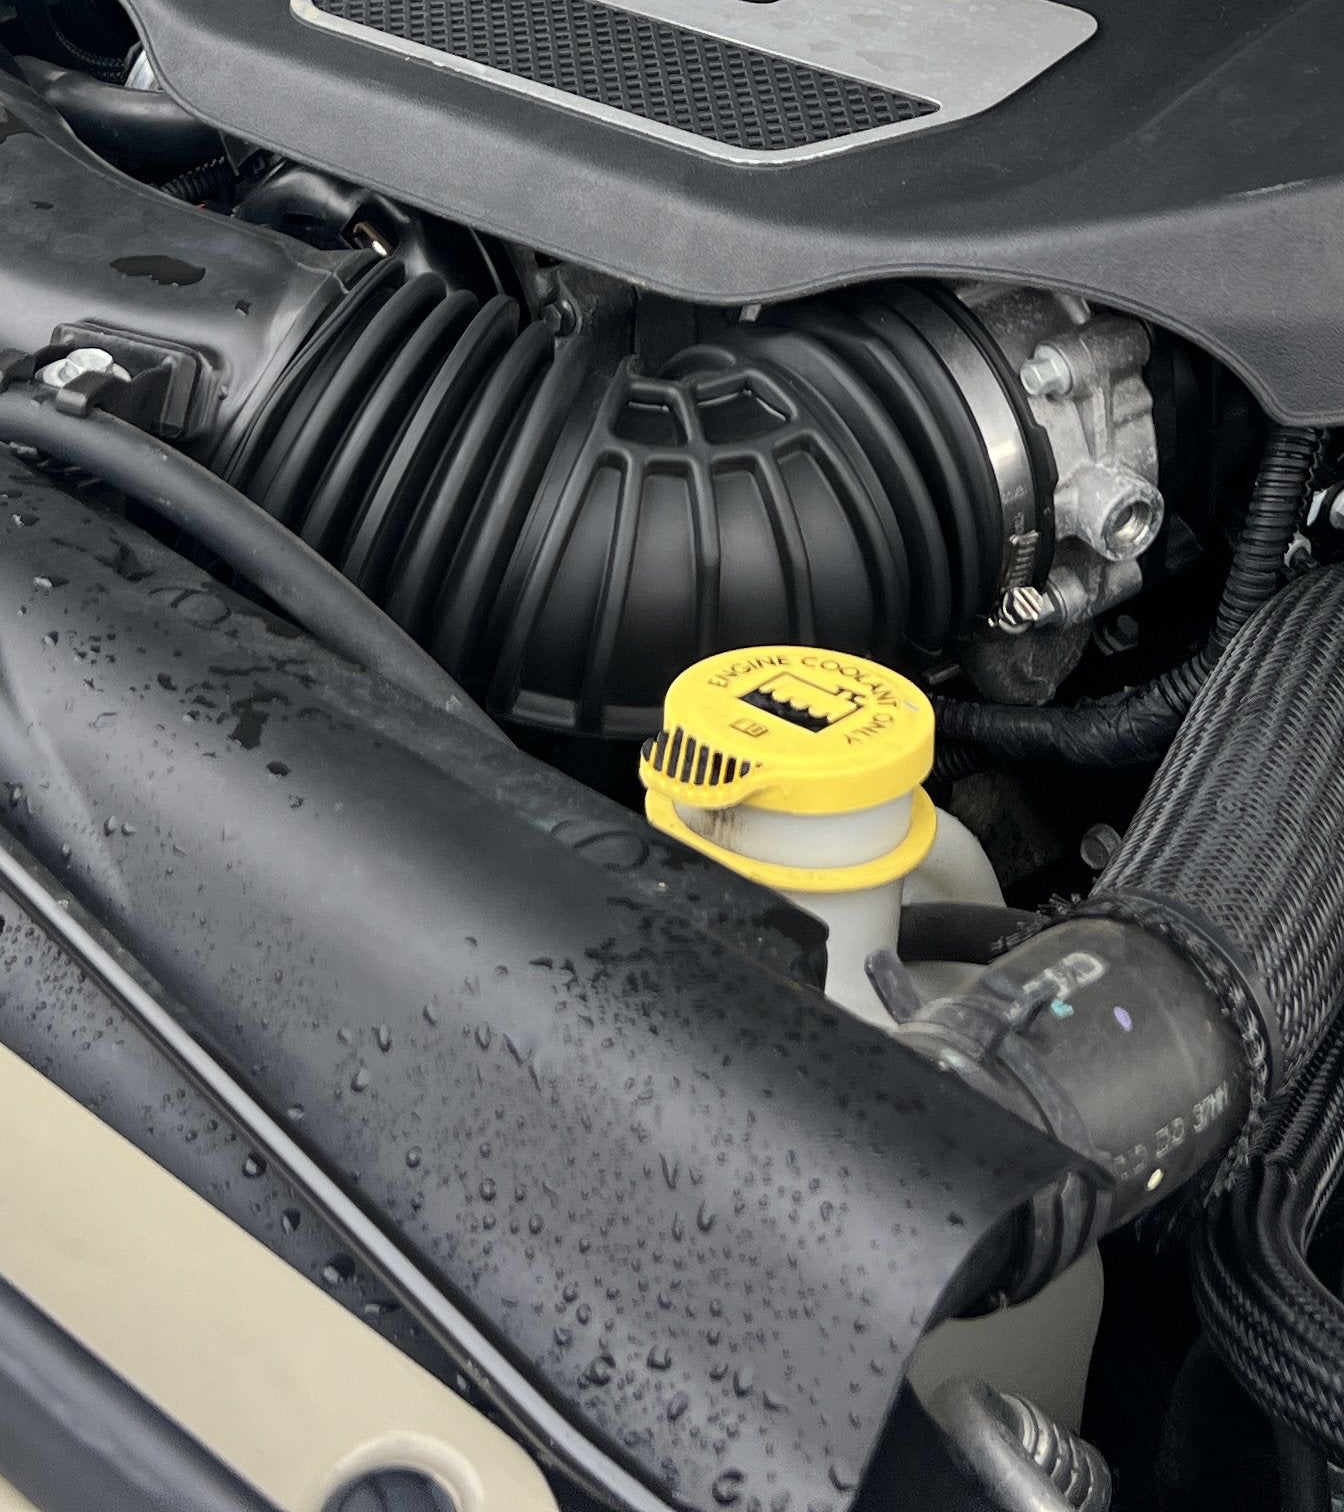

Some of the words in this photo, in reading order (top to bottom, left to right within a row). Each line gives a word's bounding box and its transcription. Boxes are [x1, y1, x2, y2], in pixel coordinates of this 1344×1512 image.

[708, 654, 791, 689] ENGINE
[801, 656, 898, 711] COOLANT
[843, 713, 896, 745] ONLY
